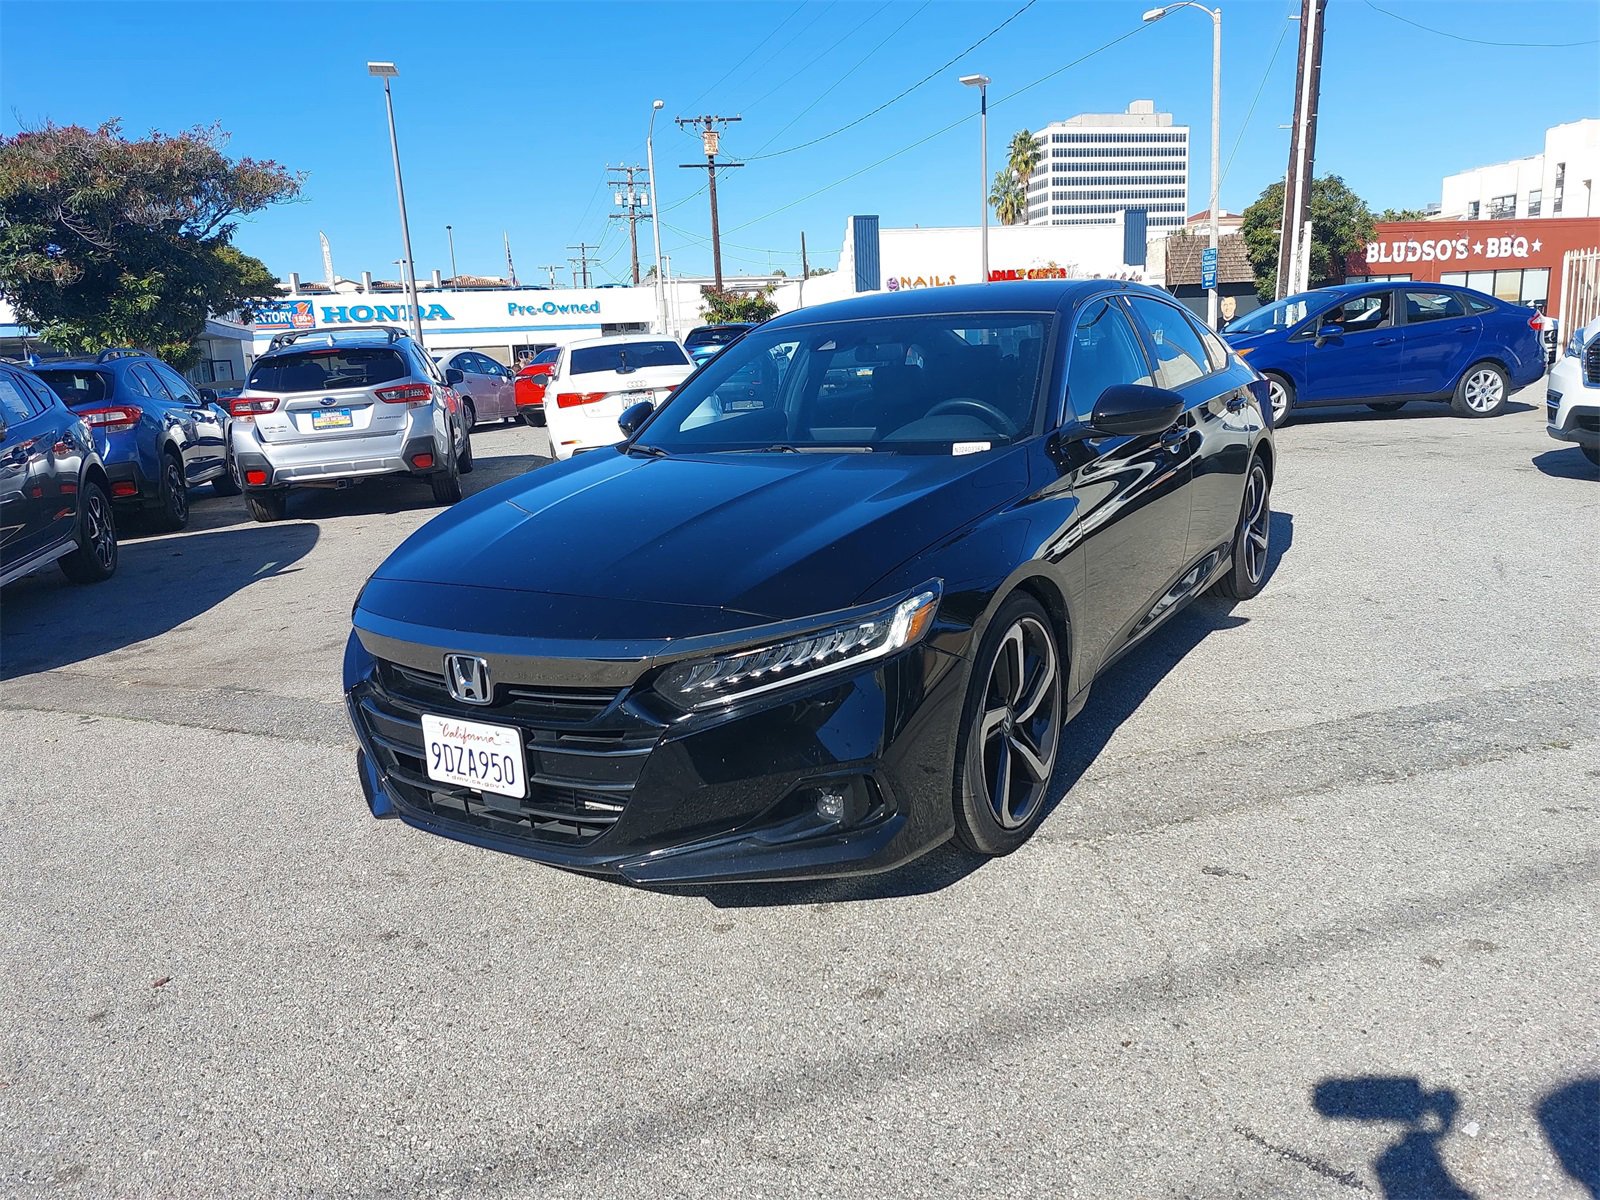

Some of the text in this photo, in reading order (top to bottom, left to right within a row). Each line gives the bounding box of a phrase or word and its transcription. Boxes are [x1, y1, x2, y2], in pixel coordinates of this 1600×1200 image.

[1365, 236, 1529, 263] BLUDSO'S BBQ
[901, 275, 957, 288] NAILS
[321, 304, 455, 323] HONDA
[508, 300, 600, 316] Pre-Owned
[442, 723, 500, 745] California
[431, 742, 515, 785] 9DZA950
